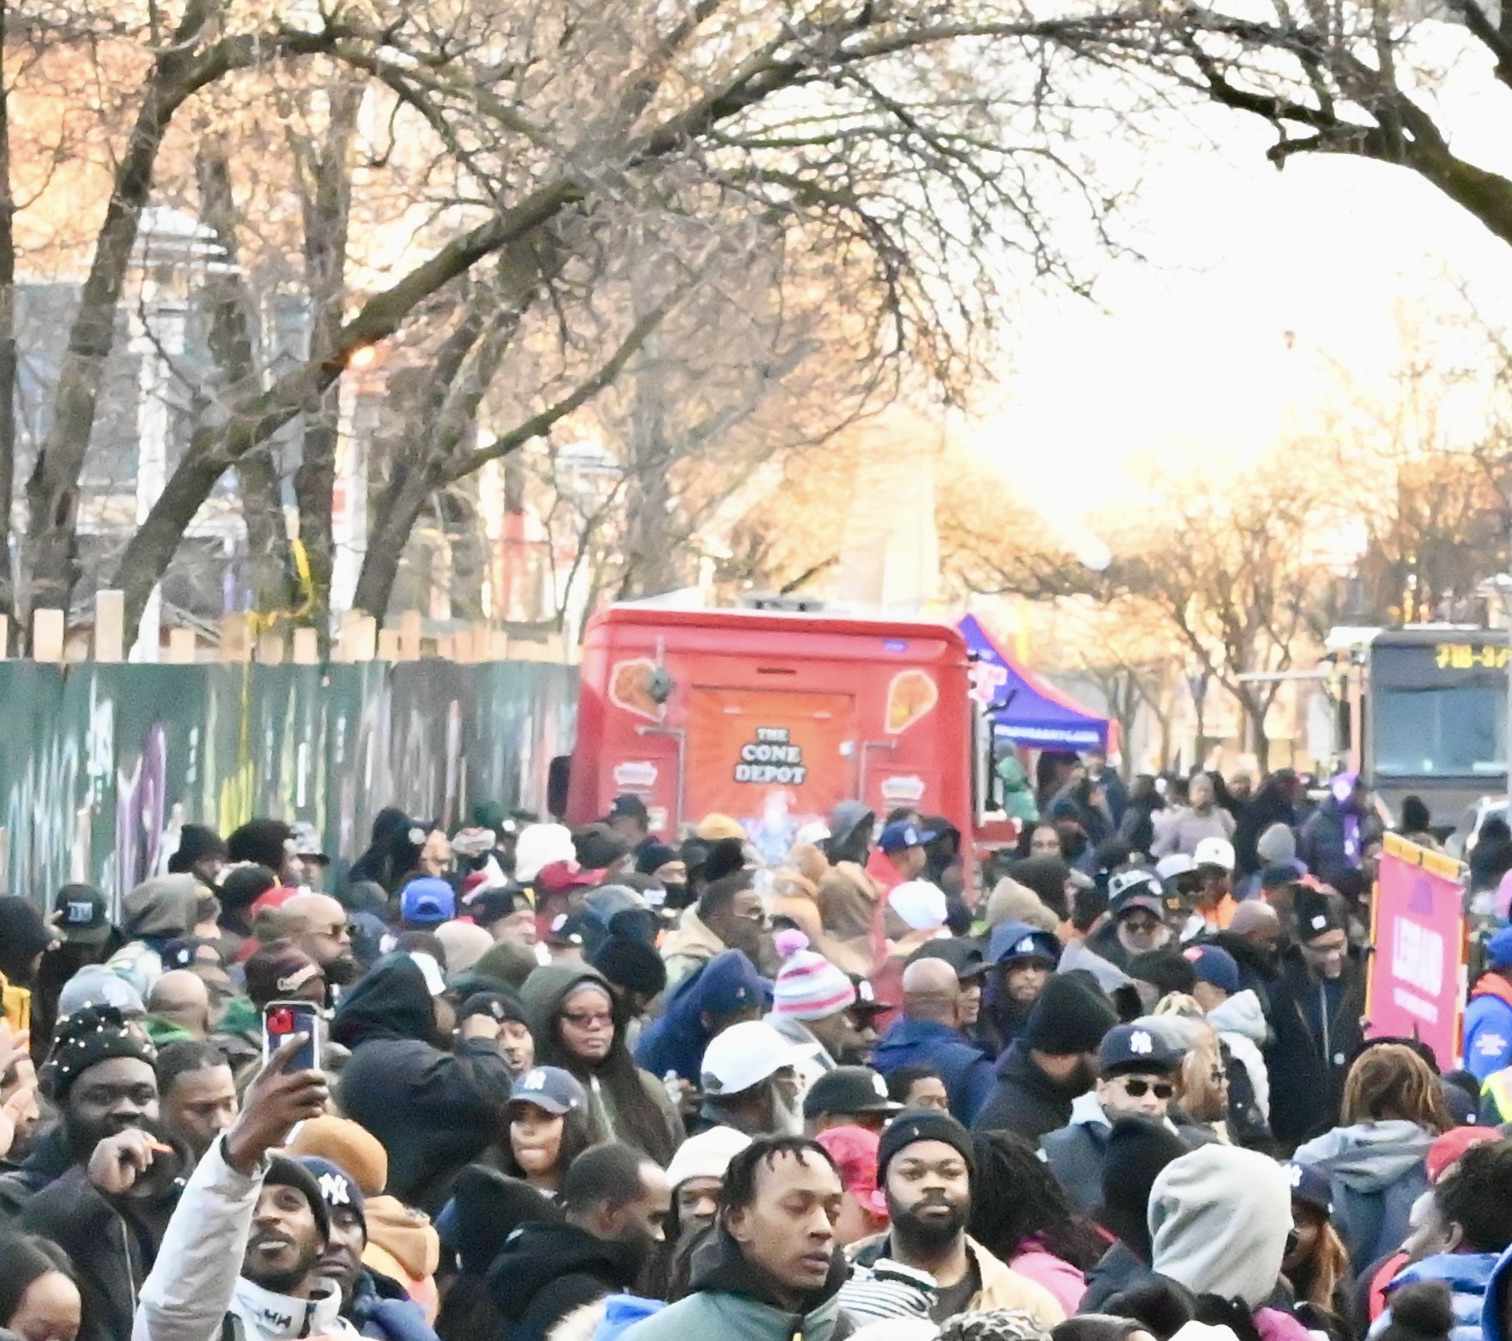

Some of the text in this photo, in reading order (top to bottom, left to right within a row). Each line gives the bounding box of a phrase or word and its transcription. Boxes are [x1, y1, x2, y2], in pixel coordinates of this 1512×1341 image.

[756, 728, 789, 741] THE
[741, 744, 802, 763] CONE
[734, 764, 807, 784] DEPOT
